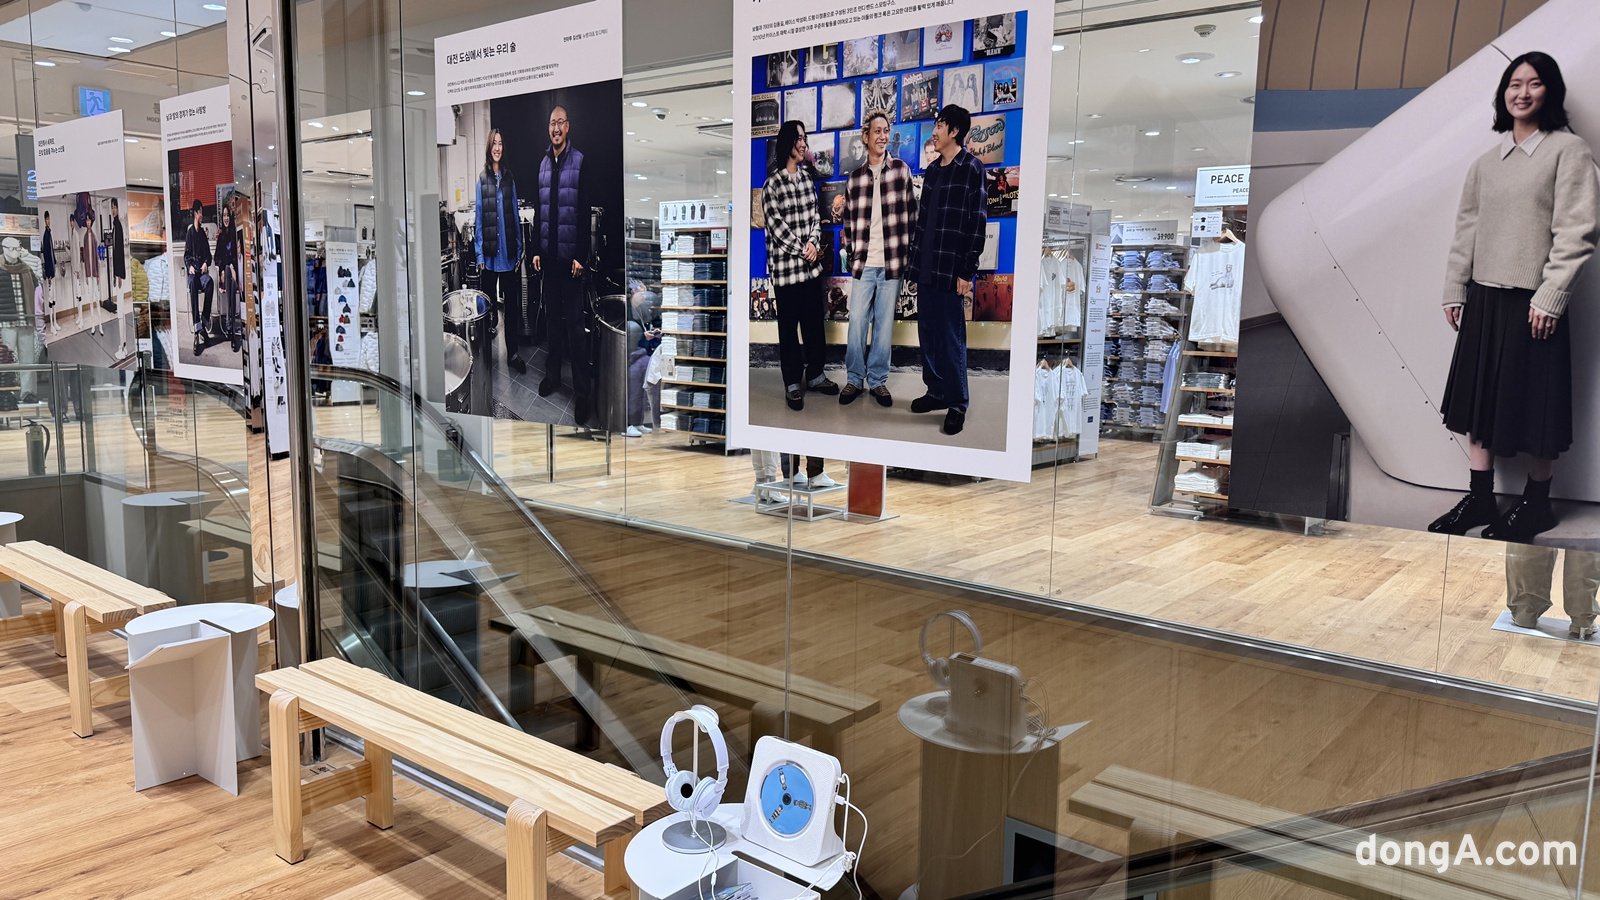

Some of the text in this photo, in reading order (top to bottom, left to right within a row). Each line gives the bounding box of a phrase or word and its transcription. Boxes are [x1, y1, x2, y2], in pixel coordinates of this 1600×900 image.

[446, 53, 458, 65] 대전
[459, 48, 482, 62] 도심에서
[496, 42, 509, 55] 우리
[510, 42, 516, 53] 술
[1210, 173, 1244, 184] PEACE
